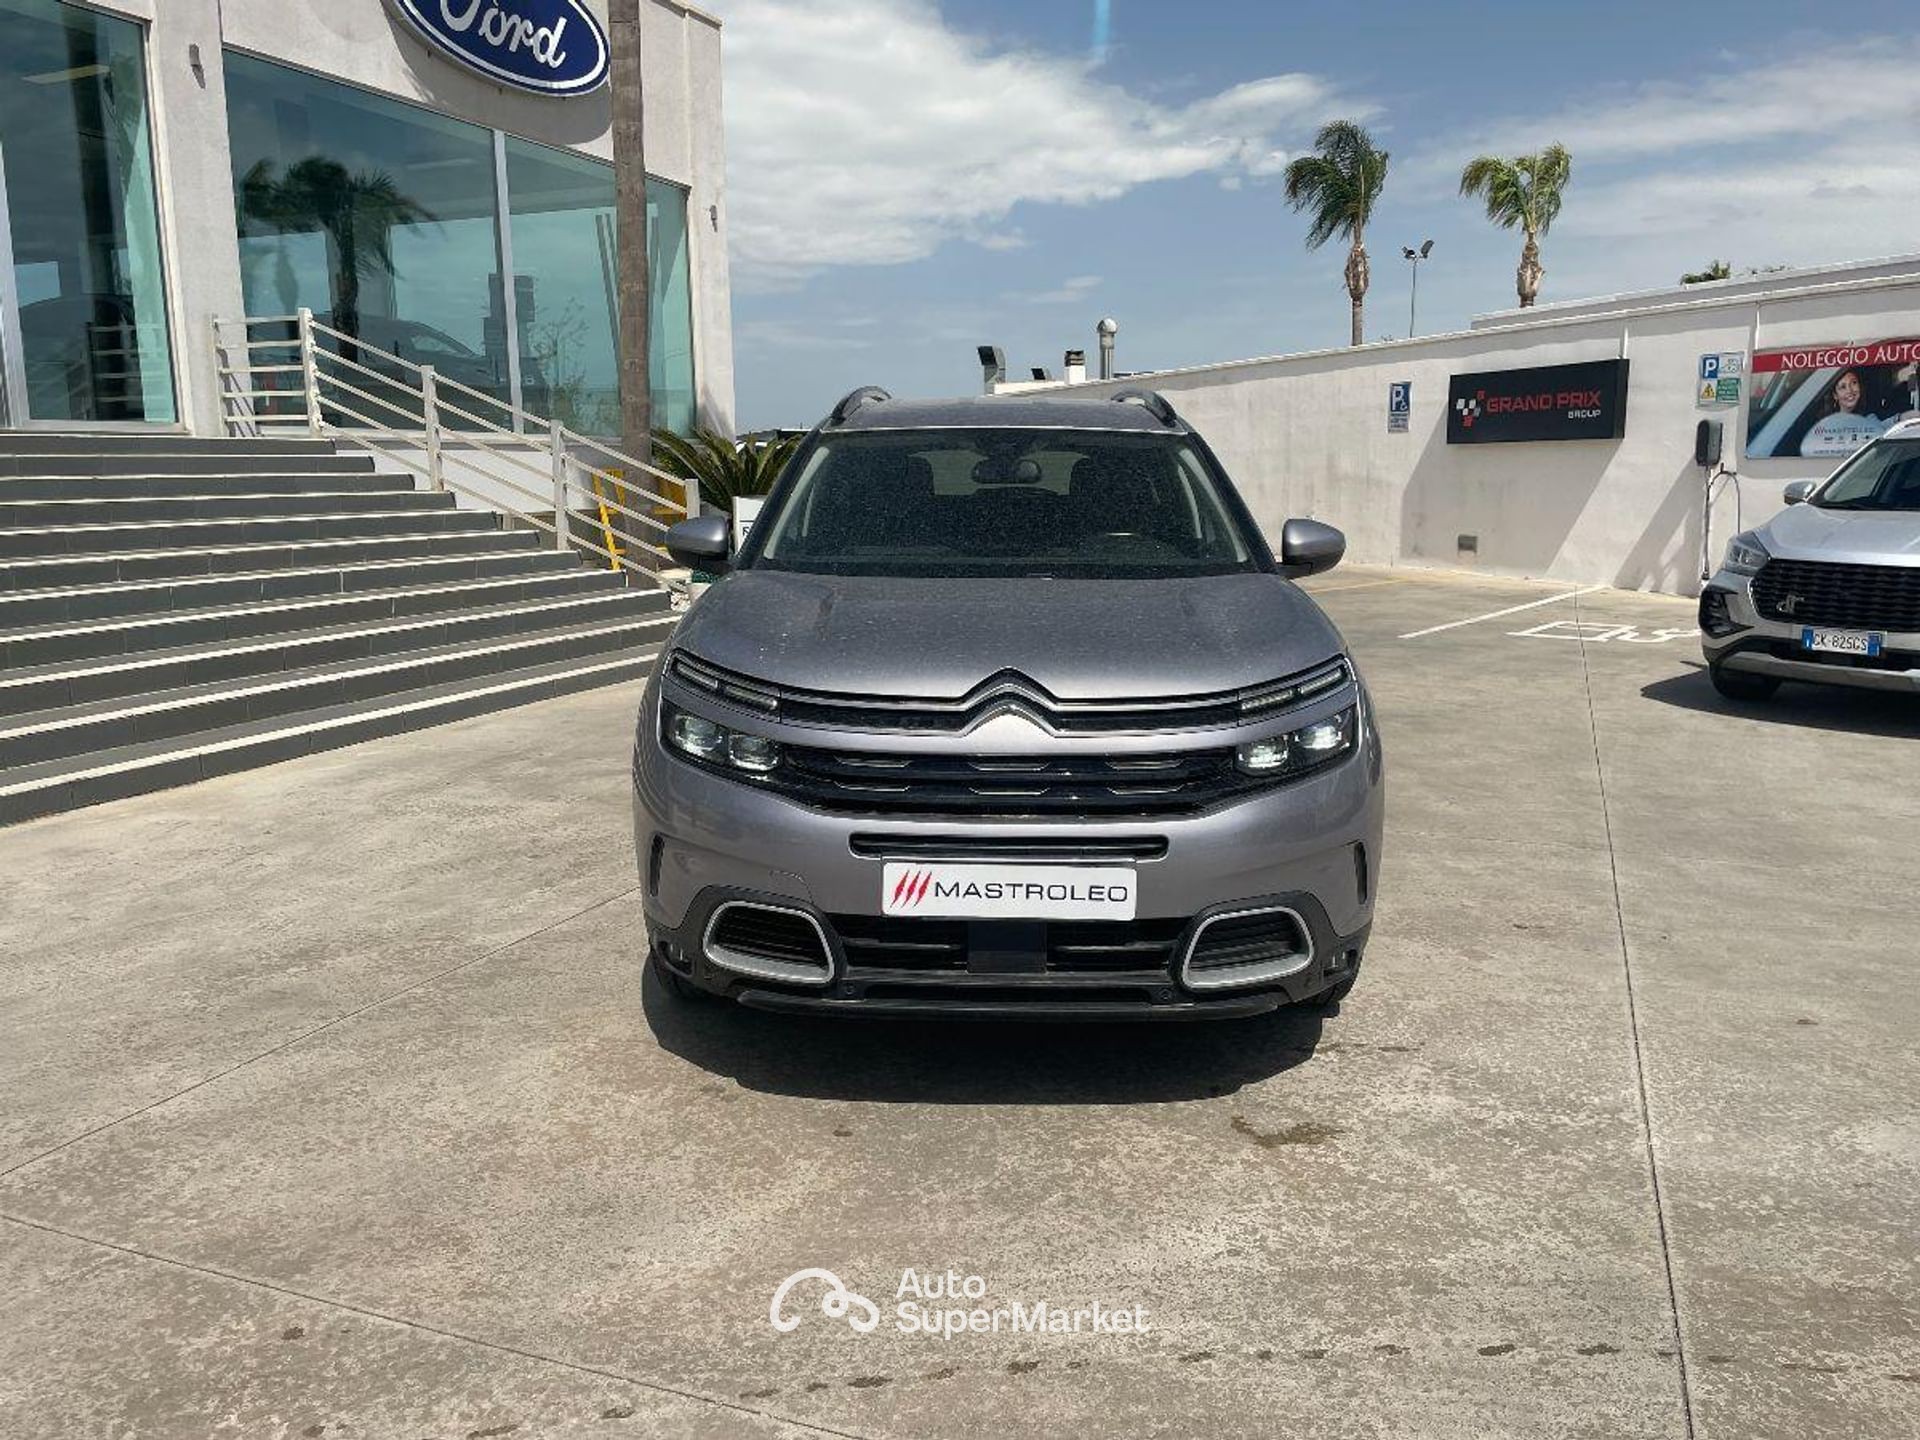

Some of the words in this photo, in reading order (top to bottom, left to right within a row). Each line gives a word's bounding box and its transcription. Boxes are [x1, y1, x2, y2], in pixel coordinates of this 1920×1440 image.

[1704, 358, 1717, 377] P
[1781, 348, 1869, 369] NOLEGGIO
[1392, 386, 1404, 411] P
[1487, 394, 1552, 413] GRAND
[1557, 390, 1601, 408] PRIX
[1568, 409, 1601, 419] GROUP
[934, 881, 1128, 903] MASTROLEO
